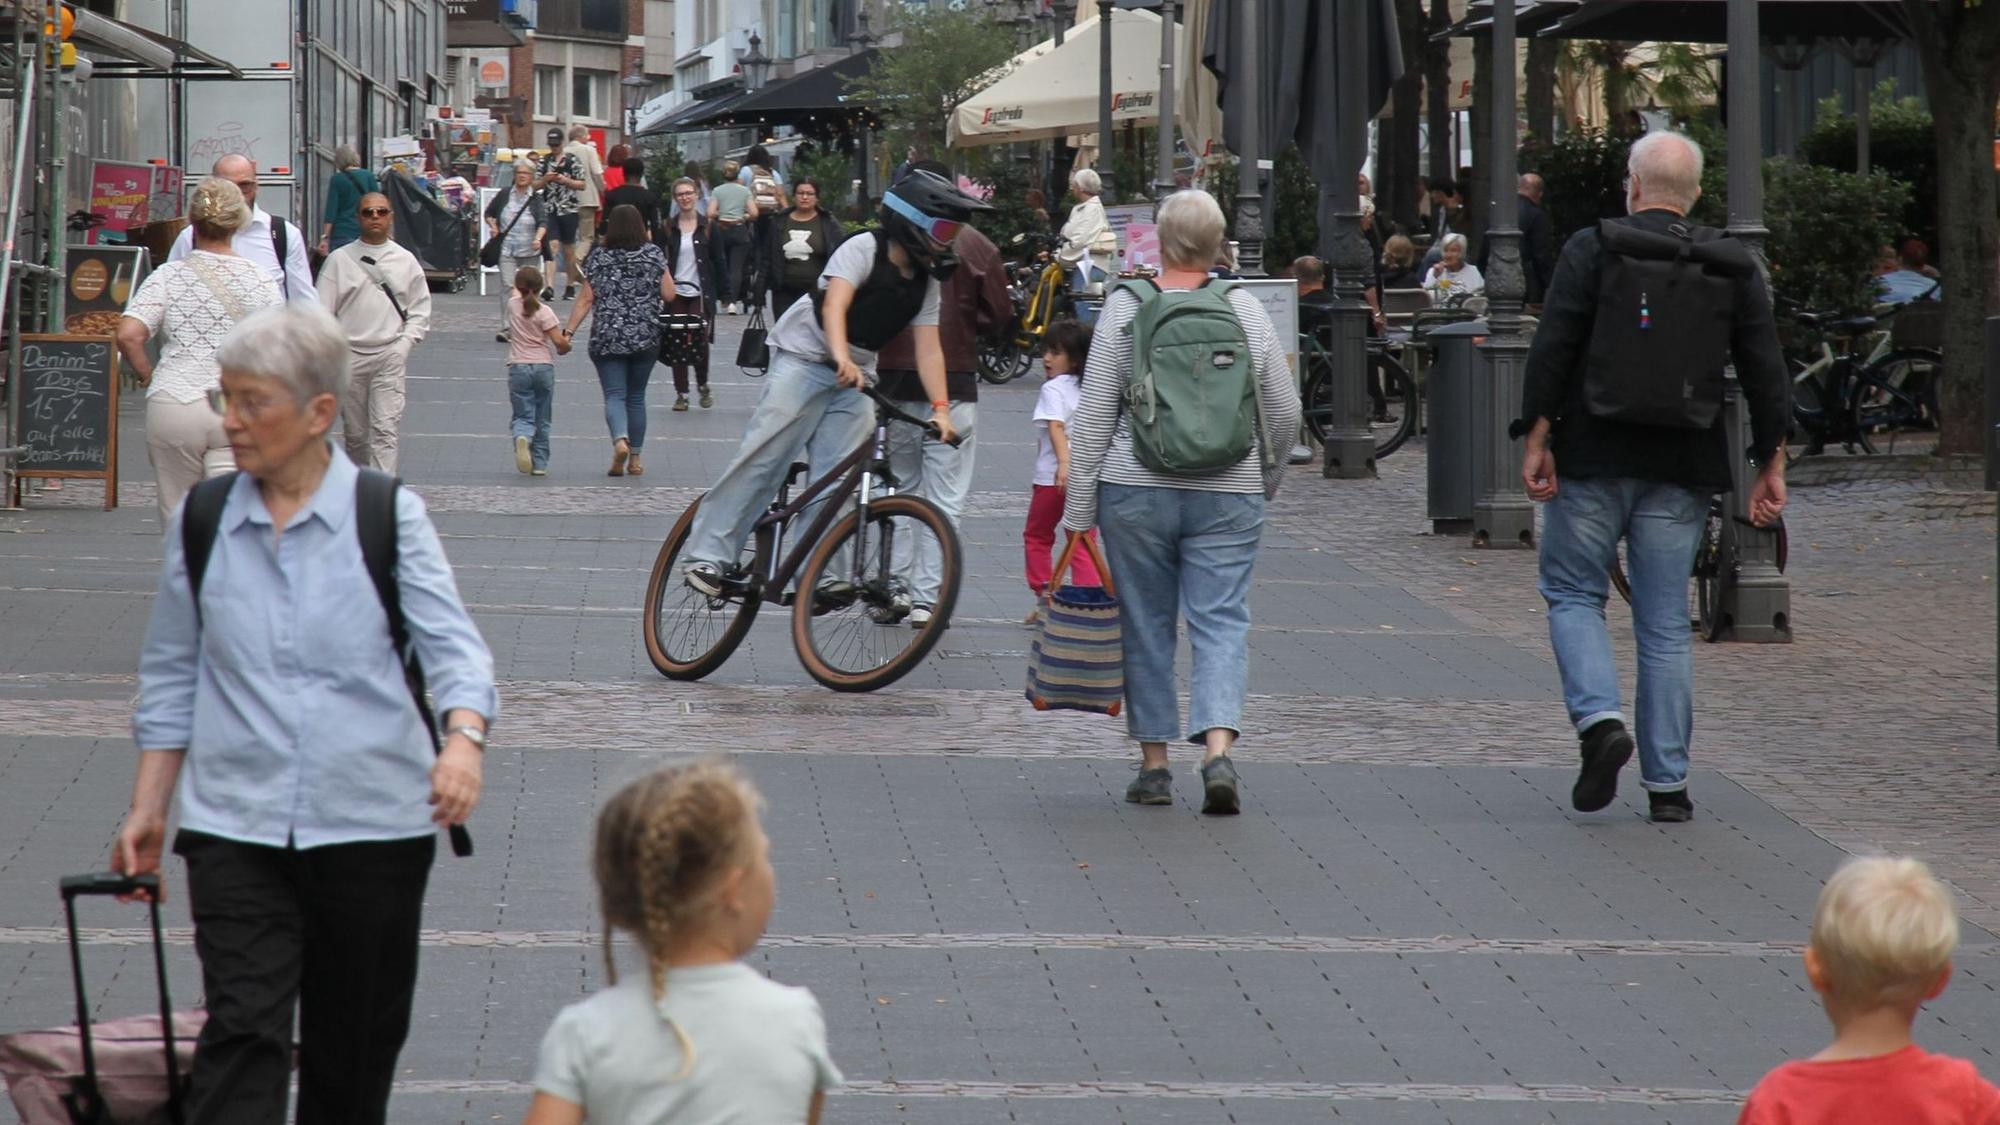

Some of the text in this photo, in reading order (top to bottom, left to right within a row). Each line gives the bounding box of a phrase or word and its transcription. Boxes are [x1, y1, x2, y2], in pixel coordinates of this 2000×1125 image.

[1111, 92, 1153, 112] Segafredo
[981, 106, 1023, 125] Segafredo
[36, 370, 92, 398] Days
[26, 394, 85, 422] 15 %
[26, 424, 95, 446] auf alle
